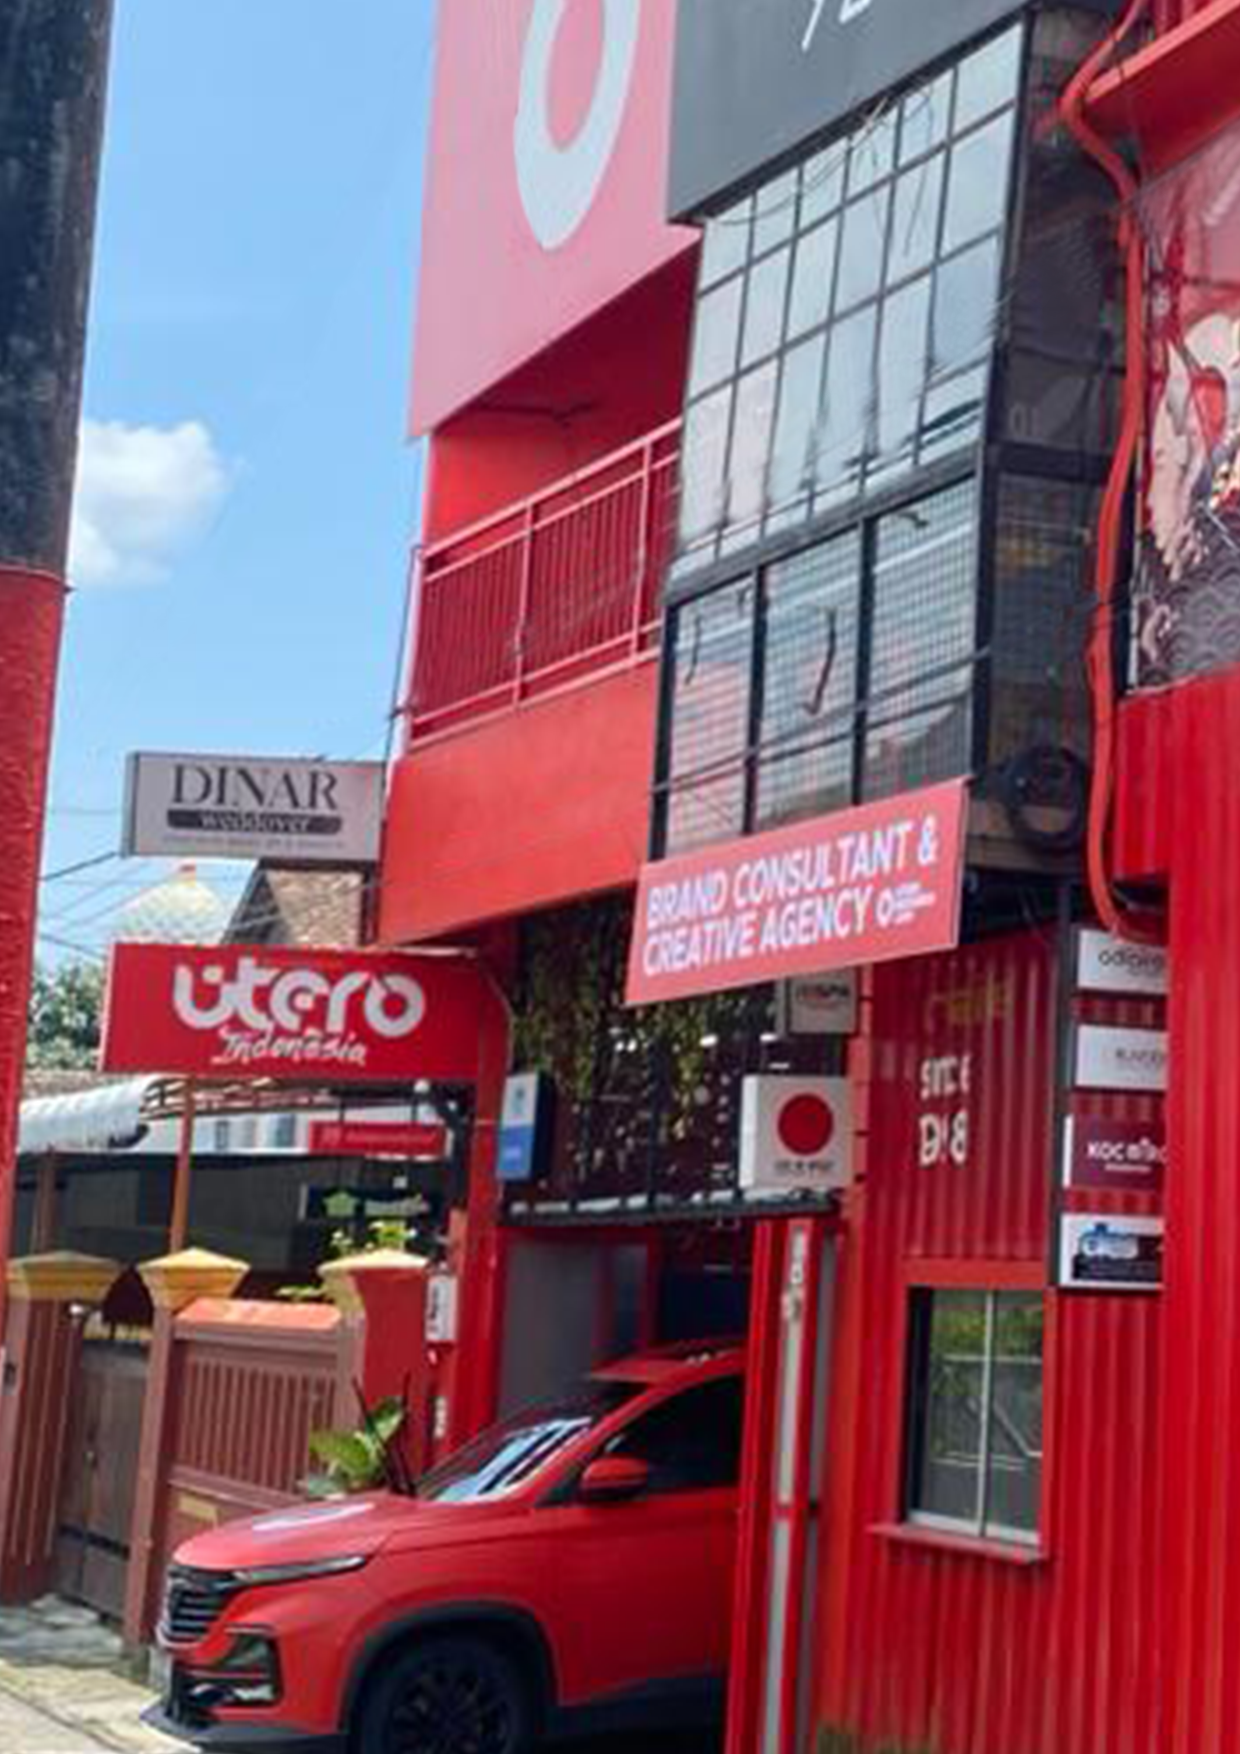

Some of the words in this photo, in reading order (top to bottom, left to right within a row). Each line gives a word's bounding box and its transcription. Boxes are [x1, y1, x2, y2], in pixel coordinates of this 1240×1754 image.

[173, 764, 338, 810] DINAR
[647, 870, 728, 931] BRAND
[733, 822, 912, 908] CONSULTANT
[917, 815, 938, 866] &
[642, 910, 758, 976] CREATIVE
[759, 885, 873, 948] AGENCY
